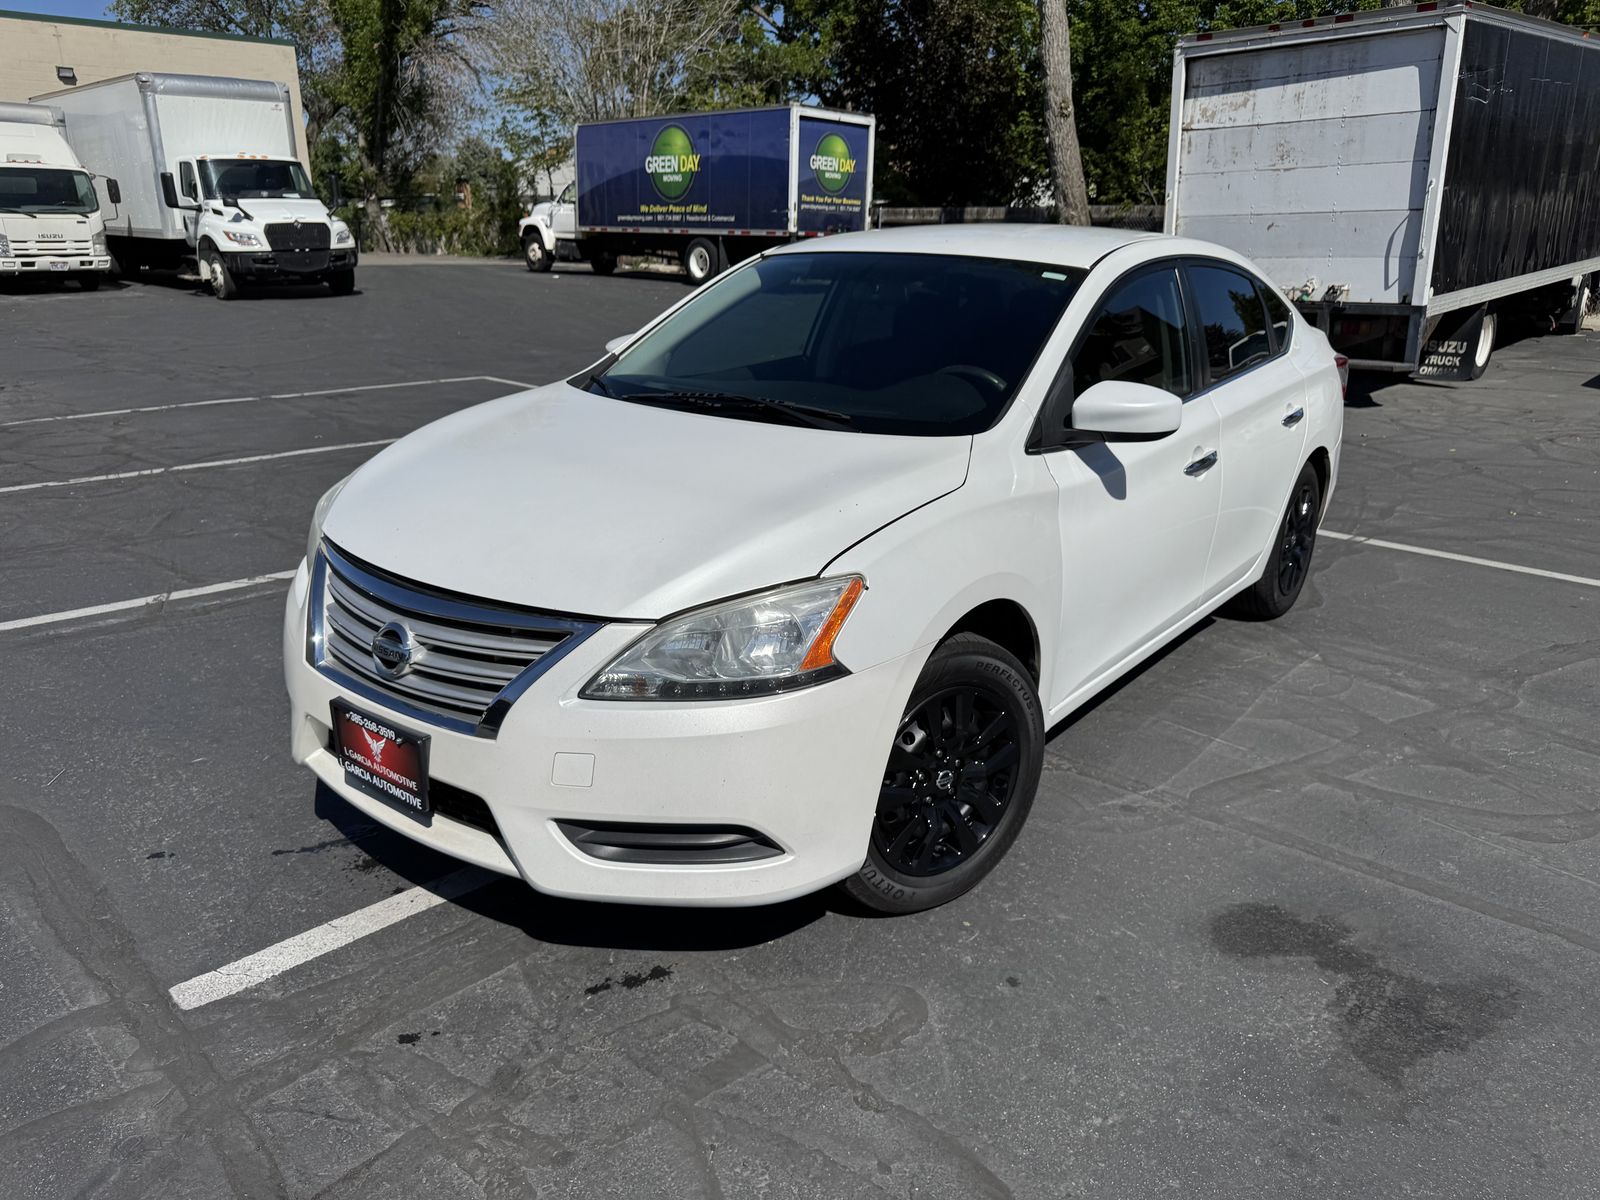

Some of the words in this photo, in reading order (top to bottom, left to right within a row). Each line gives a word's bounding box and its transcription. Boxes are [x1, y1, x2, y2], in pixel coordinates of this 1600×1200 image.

[645, 155, 679, 174] GREEN
[680, 154, 701, 173] DAY
[810, 154, 839, 172] GREEN
[840, 159, 857, 174] DAY
[663, 174, 683, 183] MOVING
[825, 172, 842, 180] MOVING
[640, 206, 648, 214] We
[649, 205, 668, 214] Deliver
[668, 204, 685, 214] Peace
[686, 204, 692, 213] of
[692, 204, 707, 214] Mind
[1424, 340, 1468, 354] ISUZU
[1425, 355, 1462, 367] TRUCK
[975, 661, 1034, 711] PERFECTUS
[348, 749, 373, 768] GARCIA
[373, 762, 418, 791] AUTOMOTIVE
[345, 761, 372, 783] GARCIA
[372, 775, 423, 810] AUTOMOTIVE
[864, 862, 917, 899] ORTU
